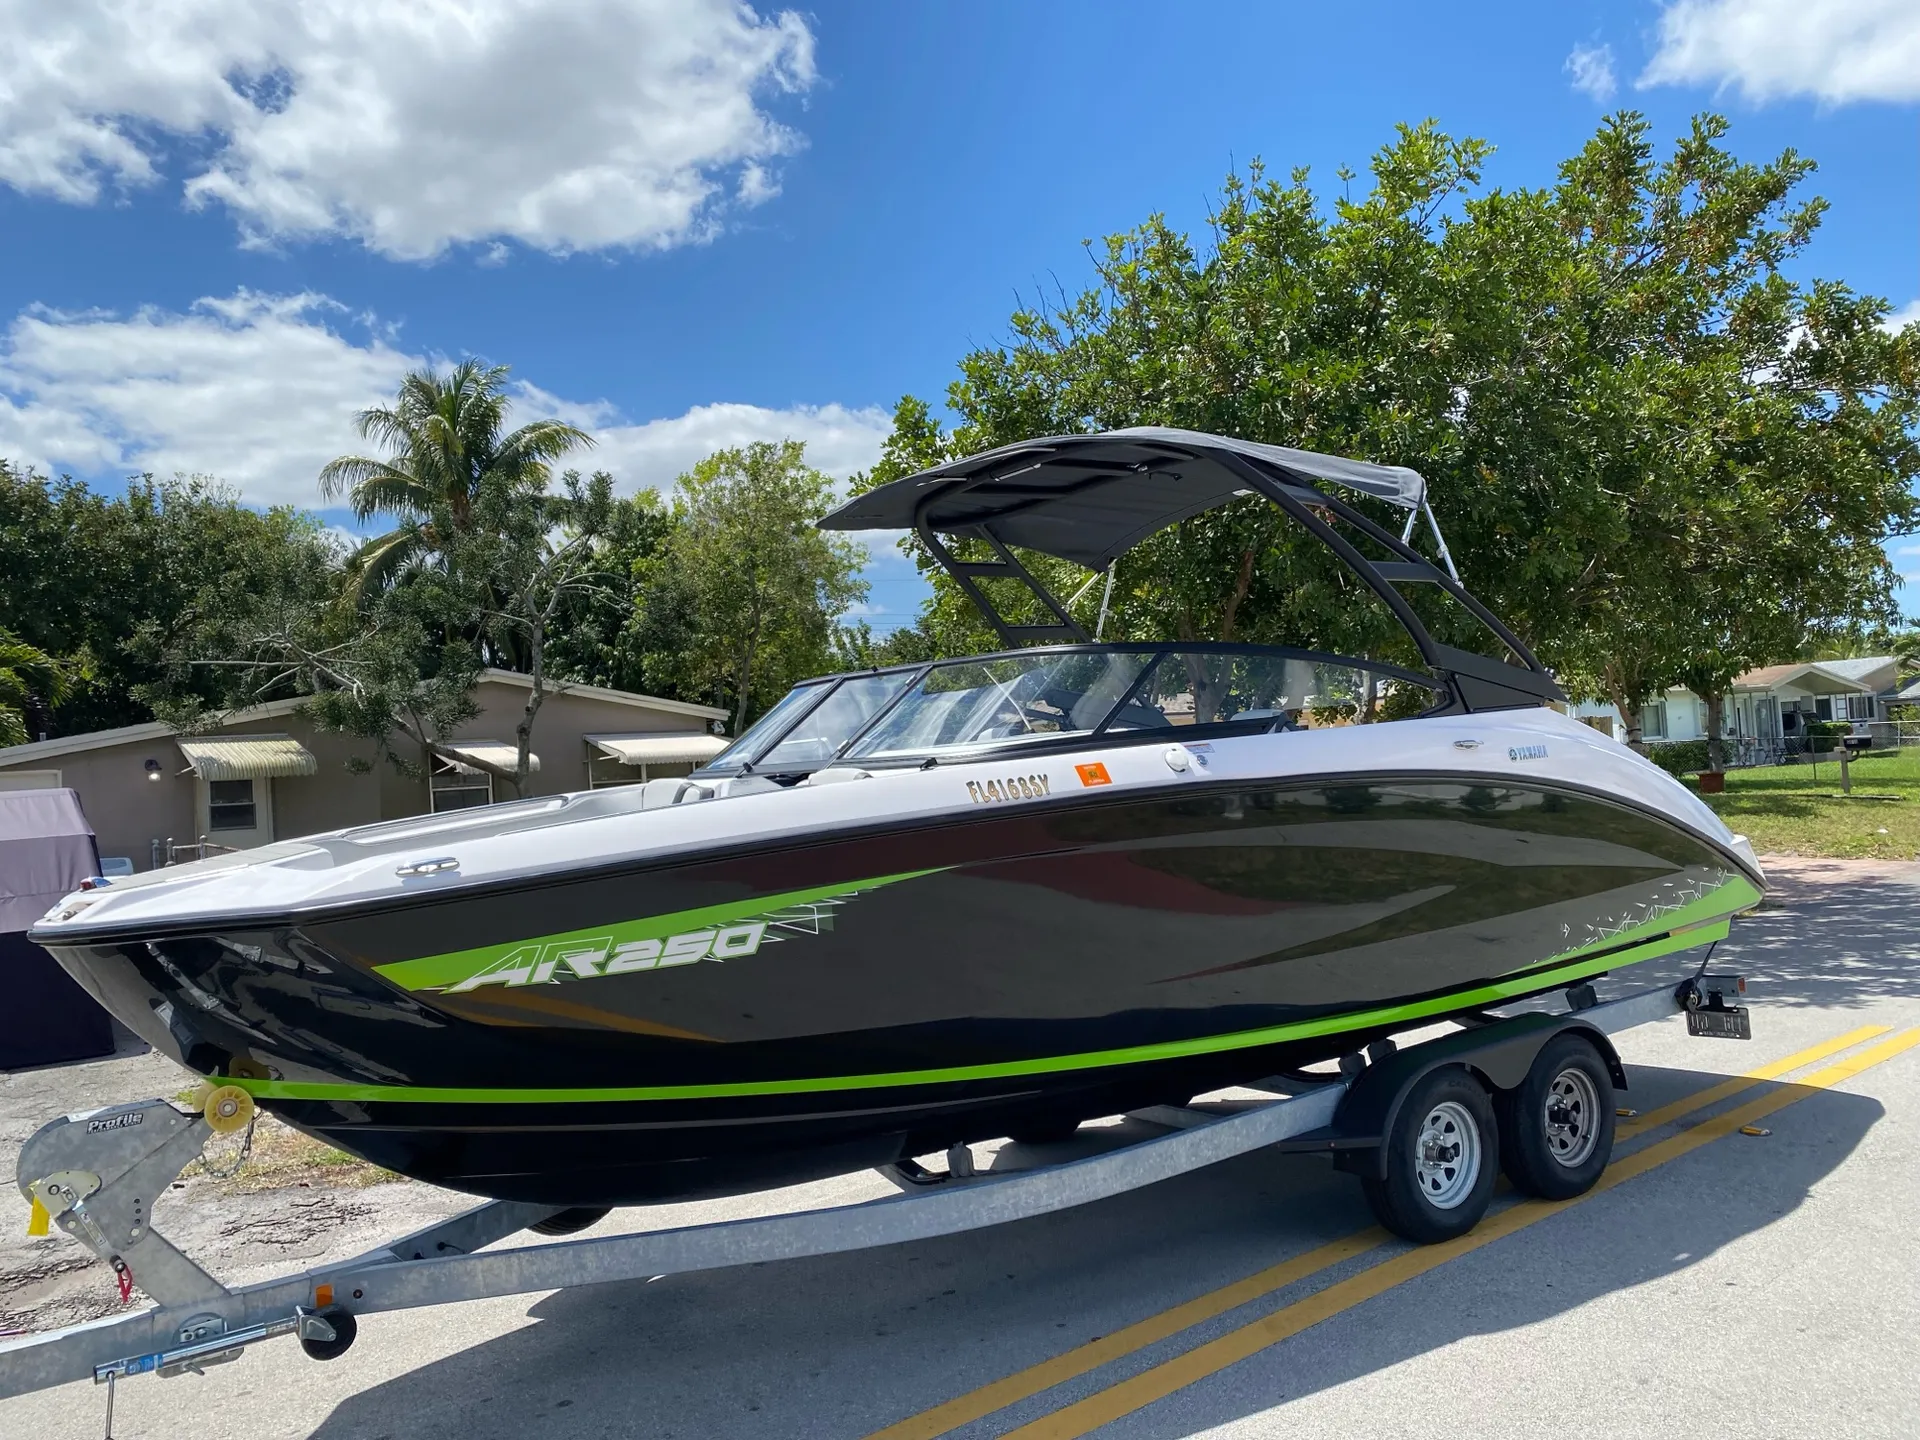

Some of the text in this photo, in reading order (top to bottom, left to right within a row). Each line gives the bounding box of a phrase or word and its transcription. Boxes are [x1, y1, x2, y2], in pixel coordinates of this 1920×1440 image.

[1516, 745, 1548, 760] YAMAHA
[966, 774, 1050, 803] FL4168SY
[441, 921, 768, 994] AR250
[87, 1113, 143, 1133] Profile
